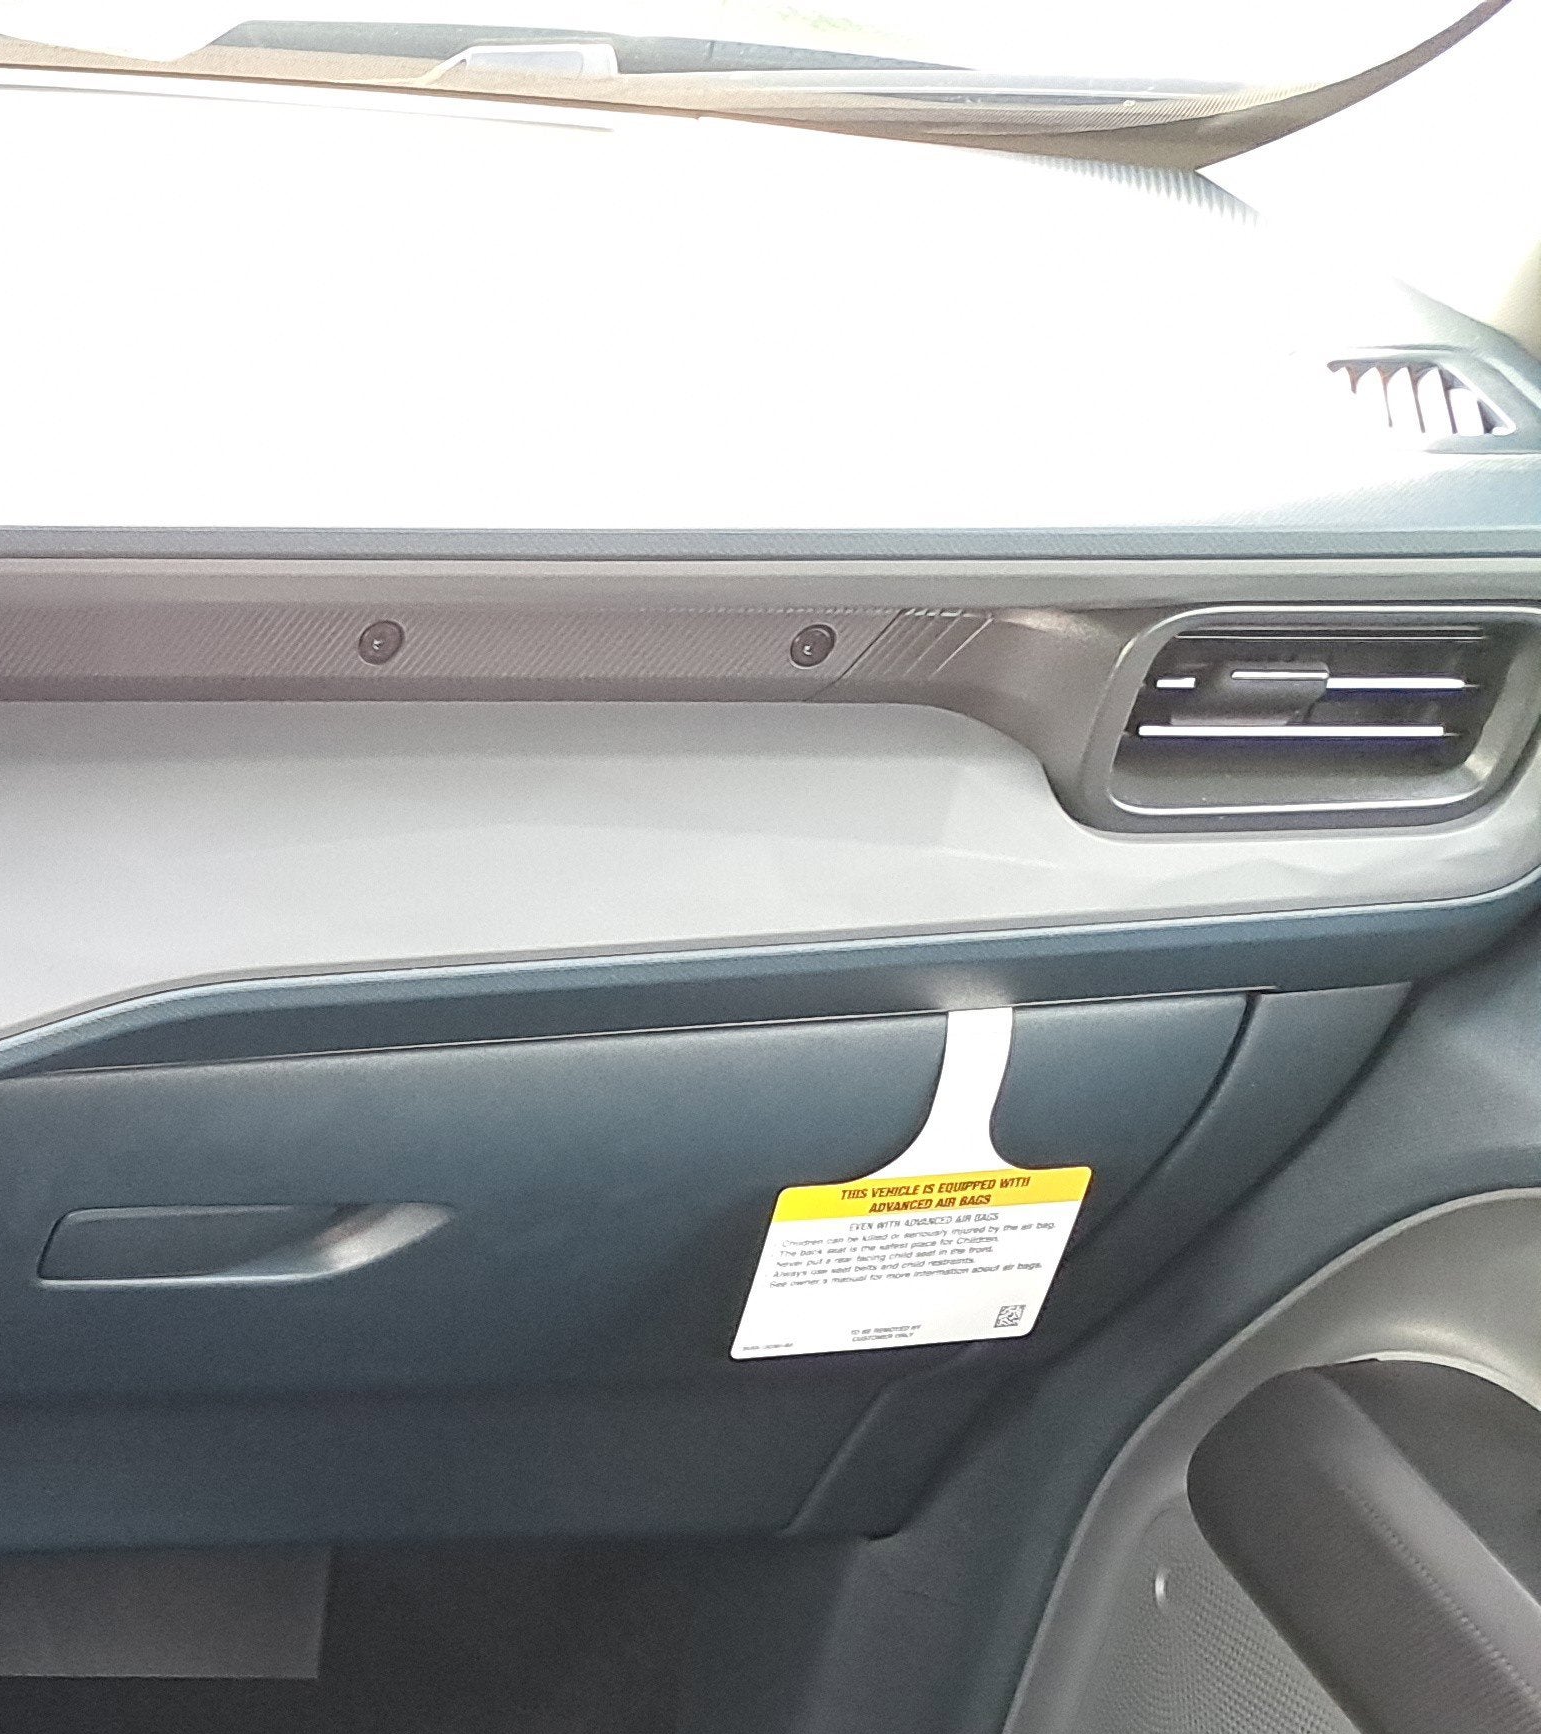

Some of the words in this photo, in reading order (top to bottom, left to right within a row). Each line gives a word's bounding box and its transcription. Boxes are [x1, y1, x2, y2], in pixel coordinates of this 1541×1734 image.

[841, 1188, 868, 1200] THIS
[871, 1184, 920, 1198] VEHICLE
[922, 1183, 935, 1194] IS
[937, 1178, 996, 1194] EQUIPPED
[999, 1176, 1031, 1188] WITH
[868, 1199, 933, 1213] ADVANCED
[935, 1197, 957, 1208] AIR
[959, 1194, 992, 1206] BAGS
